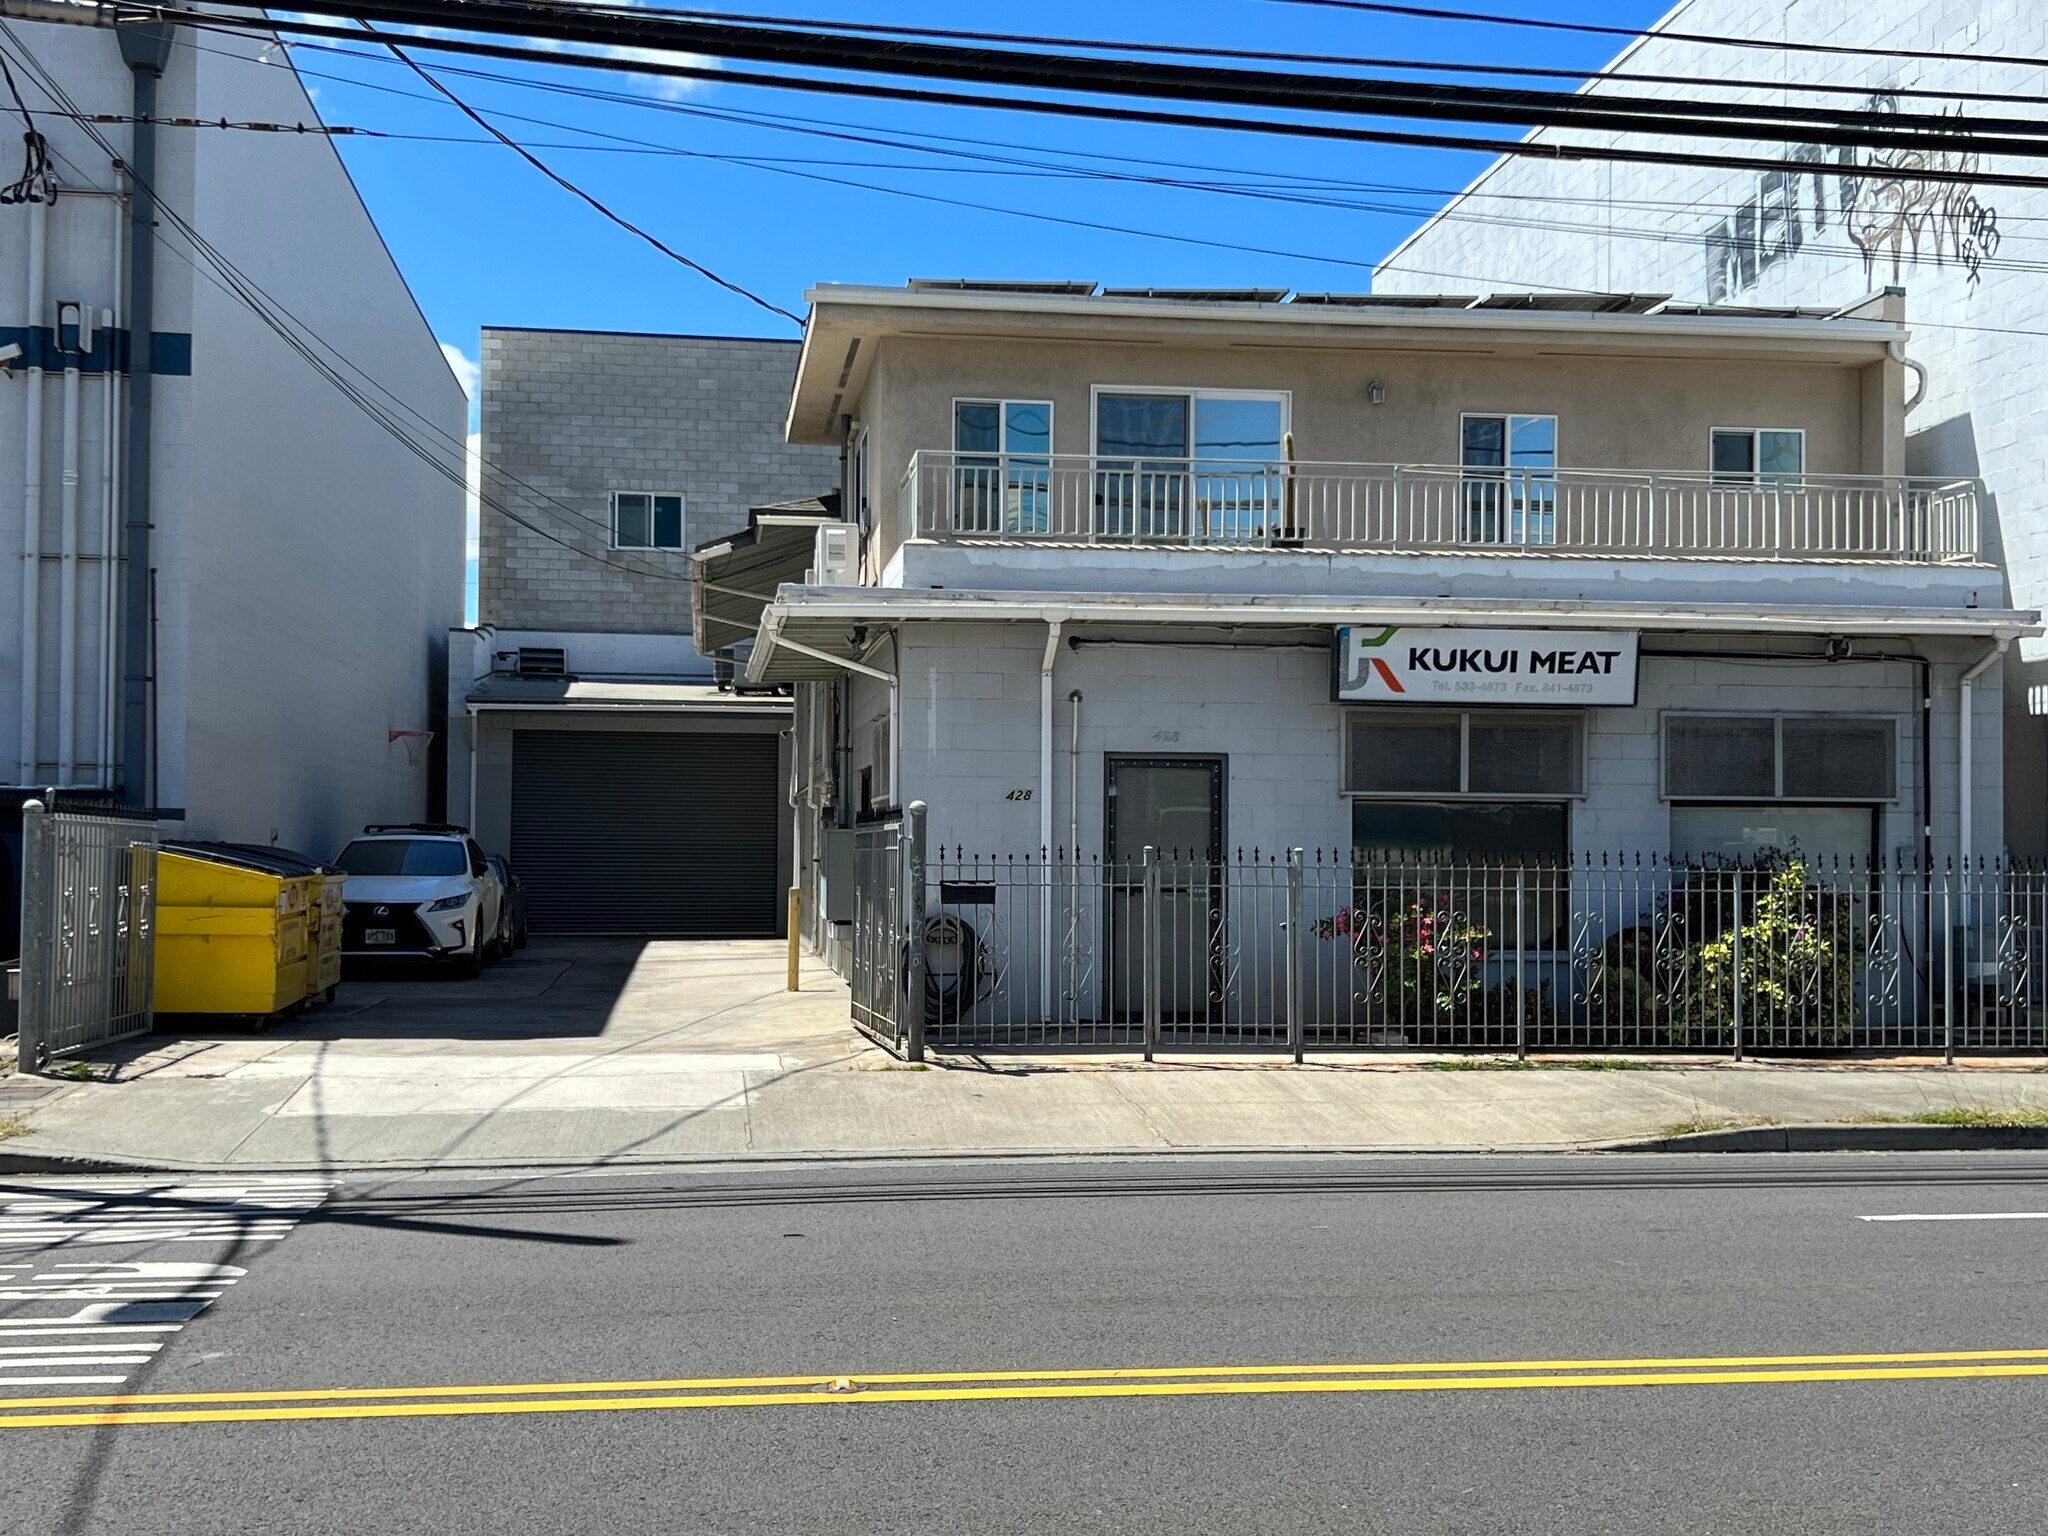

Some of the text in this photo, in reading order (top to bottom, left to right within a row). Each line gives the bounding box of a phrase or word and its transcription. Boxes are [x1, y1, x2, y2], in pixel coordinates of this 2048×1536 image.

[1408, 647, 1622, 675] KUKUI MEAT
[1431, 680, 1451, 692] Tel.
[1515, 682, 1539, 693] Fax.
[1005, 789, 1032, 801] 428
